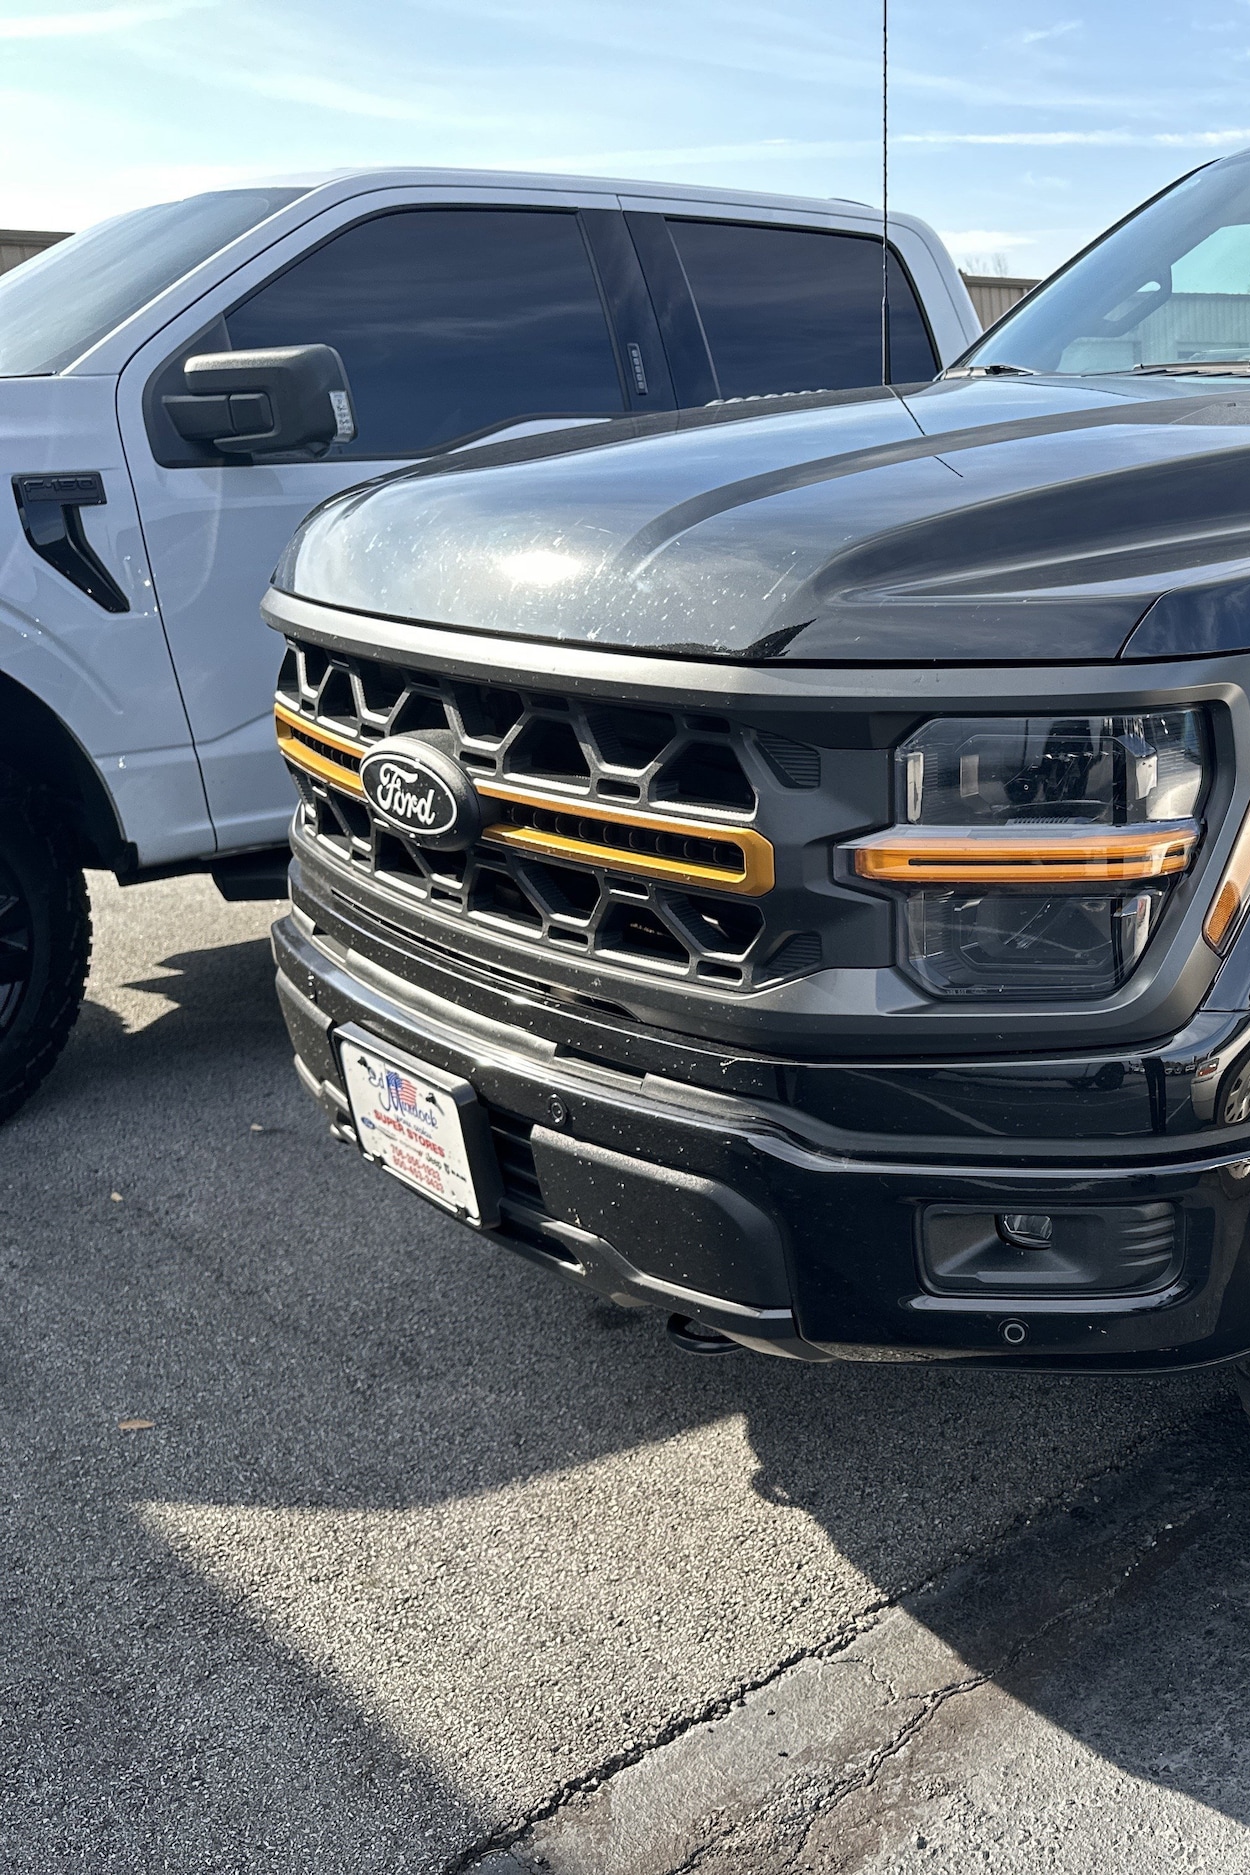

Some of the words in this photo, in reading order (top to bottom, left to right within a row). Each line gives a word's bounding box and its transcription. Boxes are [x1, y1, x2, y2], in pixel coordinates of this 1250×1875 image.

[24, 478, 97, 493] F-150
[377, 763, 436, 825] Ford
[373, 1109, 405, 1135] SUPER
[406, 1127, 445, 1158] STORES
